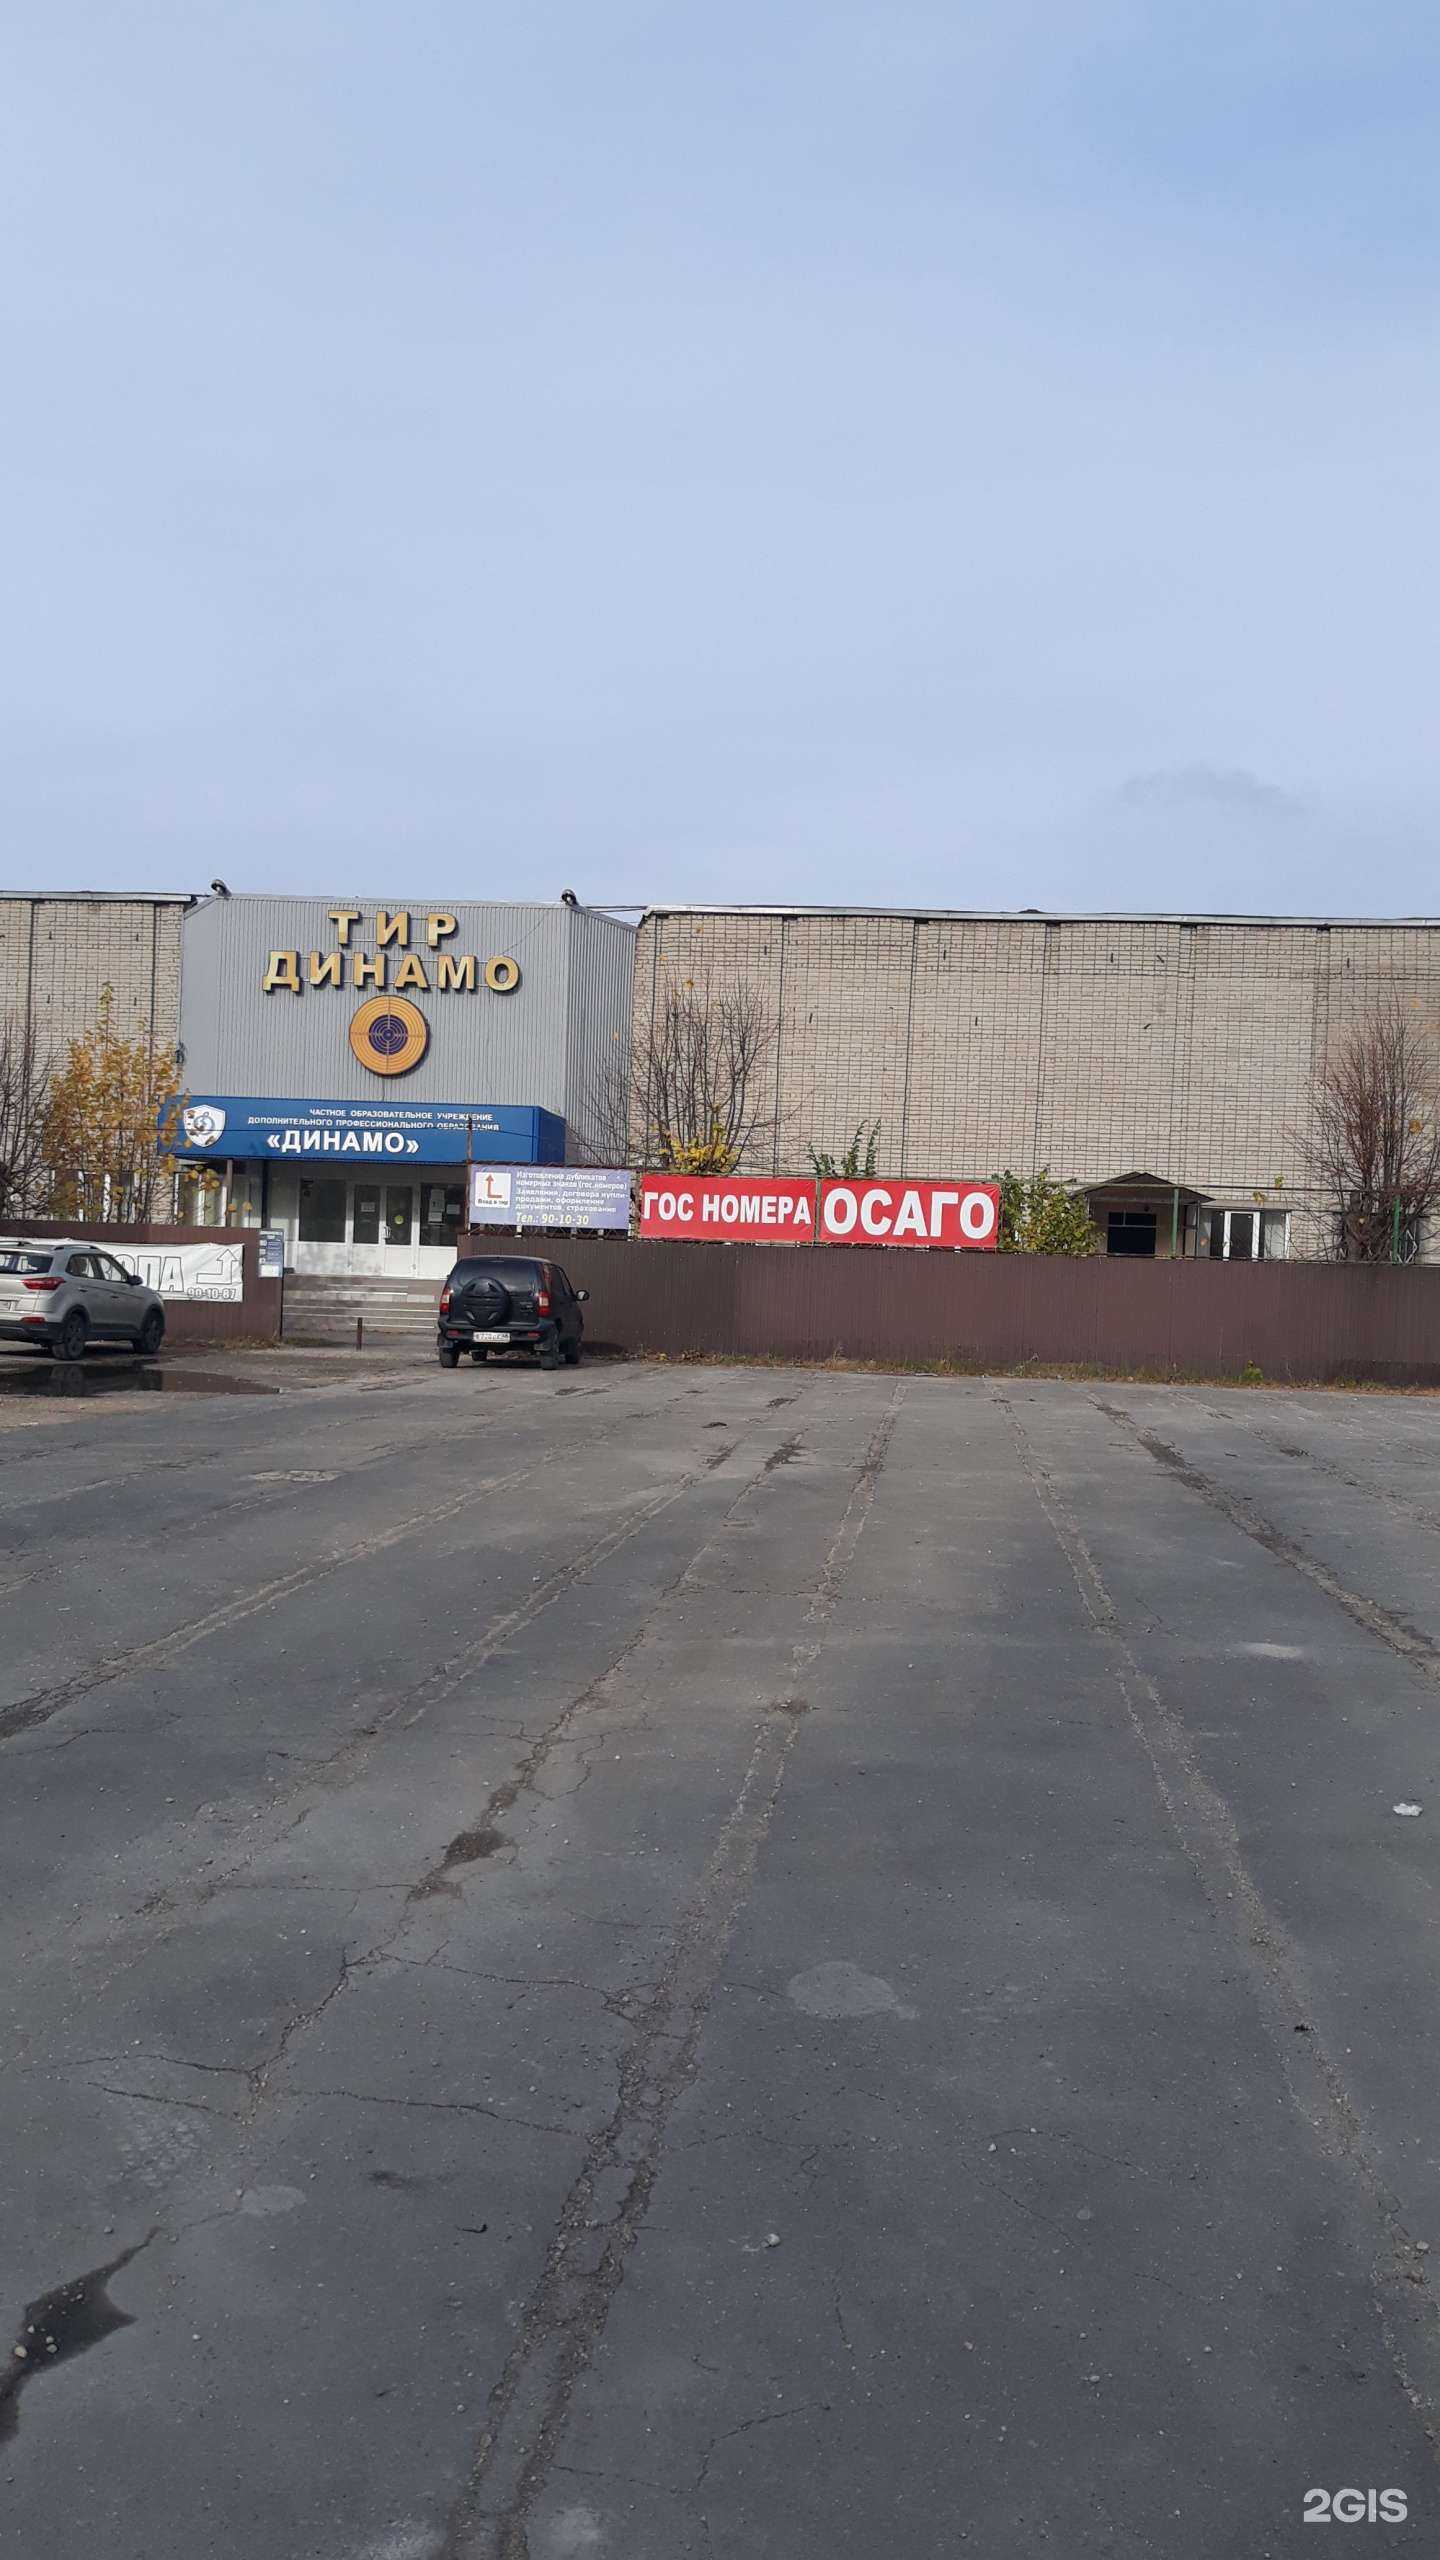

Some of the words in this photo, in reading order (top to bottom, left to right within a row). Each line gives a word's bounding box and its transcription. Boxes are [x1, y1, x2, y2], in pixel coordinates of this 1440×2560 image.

[328, 910, 458, 947] ТИР
[262, 951, 520, 993] ДИНАМО
[248, 1116, 333, 1126] ДОПОЛНИТЕЛЬНОГО
[336, 1119, 434, 1129] ПРОФЕССИОНАЛЬНОГО
[309, 1108, 347, 1117] ЧАСТНОЕ
[350, 1110, 433, 1120] ОБРАЗОВАТЕЛЬНОЕ
[266, 1129, 420, 1154] «ДИНАМО»
[566, 1173, 607, 1182] дубликатов
[643, 1191, 695, 1222] ГОС
[702, 1194, 812, 1225] НОМЕРА
[823, 1188, 996, 1240] ОСАГО
[516, 1212, 539, 1223] Тел.:
[541, 1213, 589, 1225] 90-10-30
[186, 1287, 237, 1300] 90-10-87
